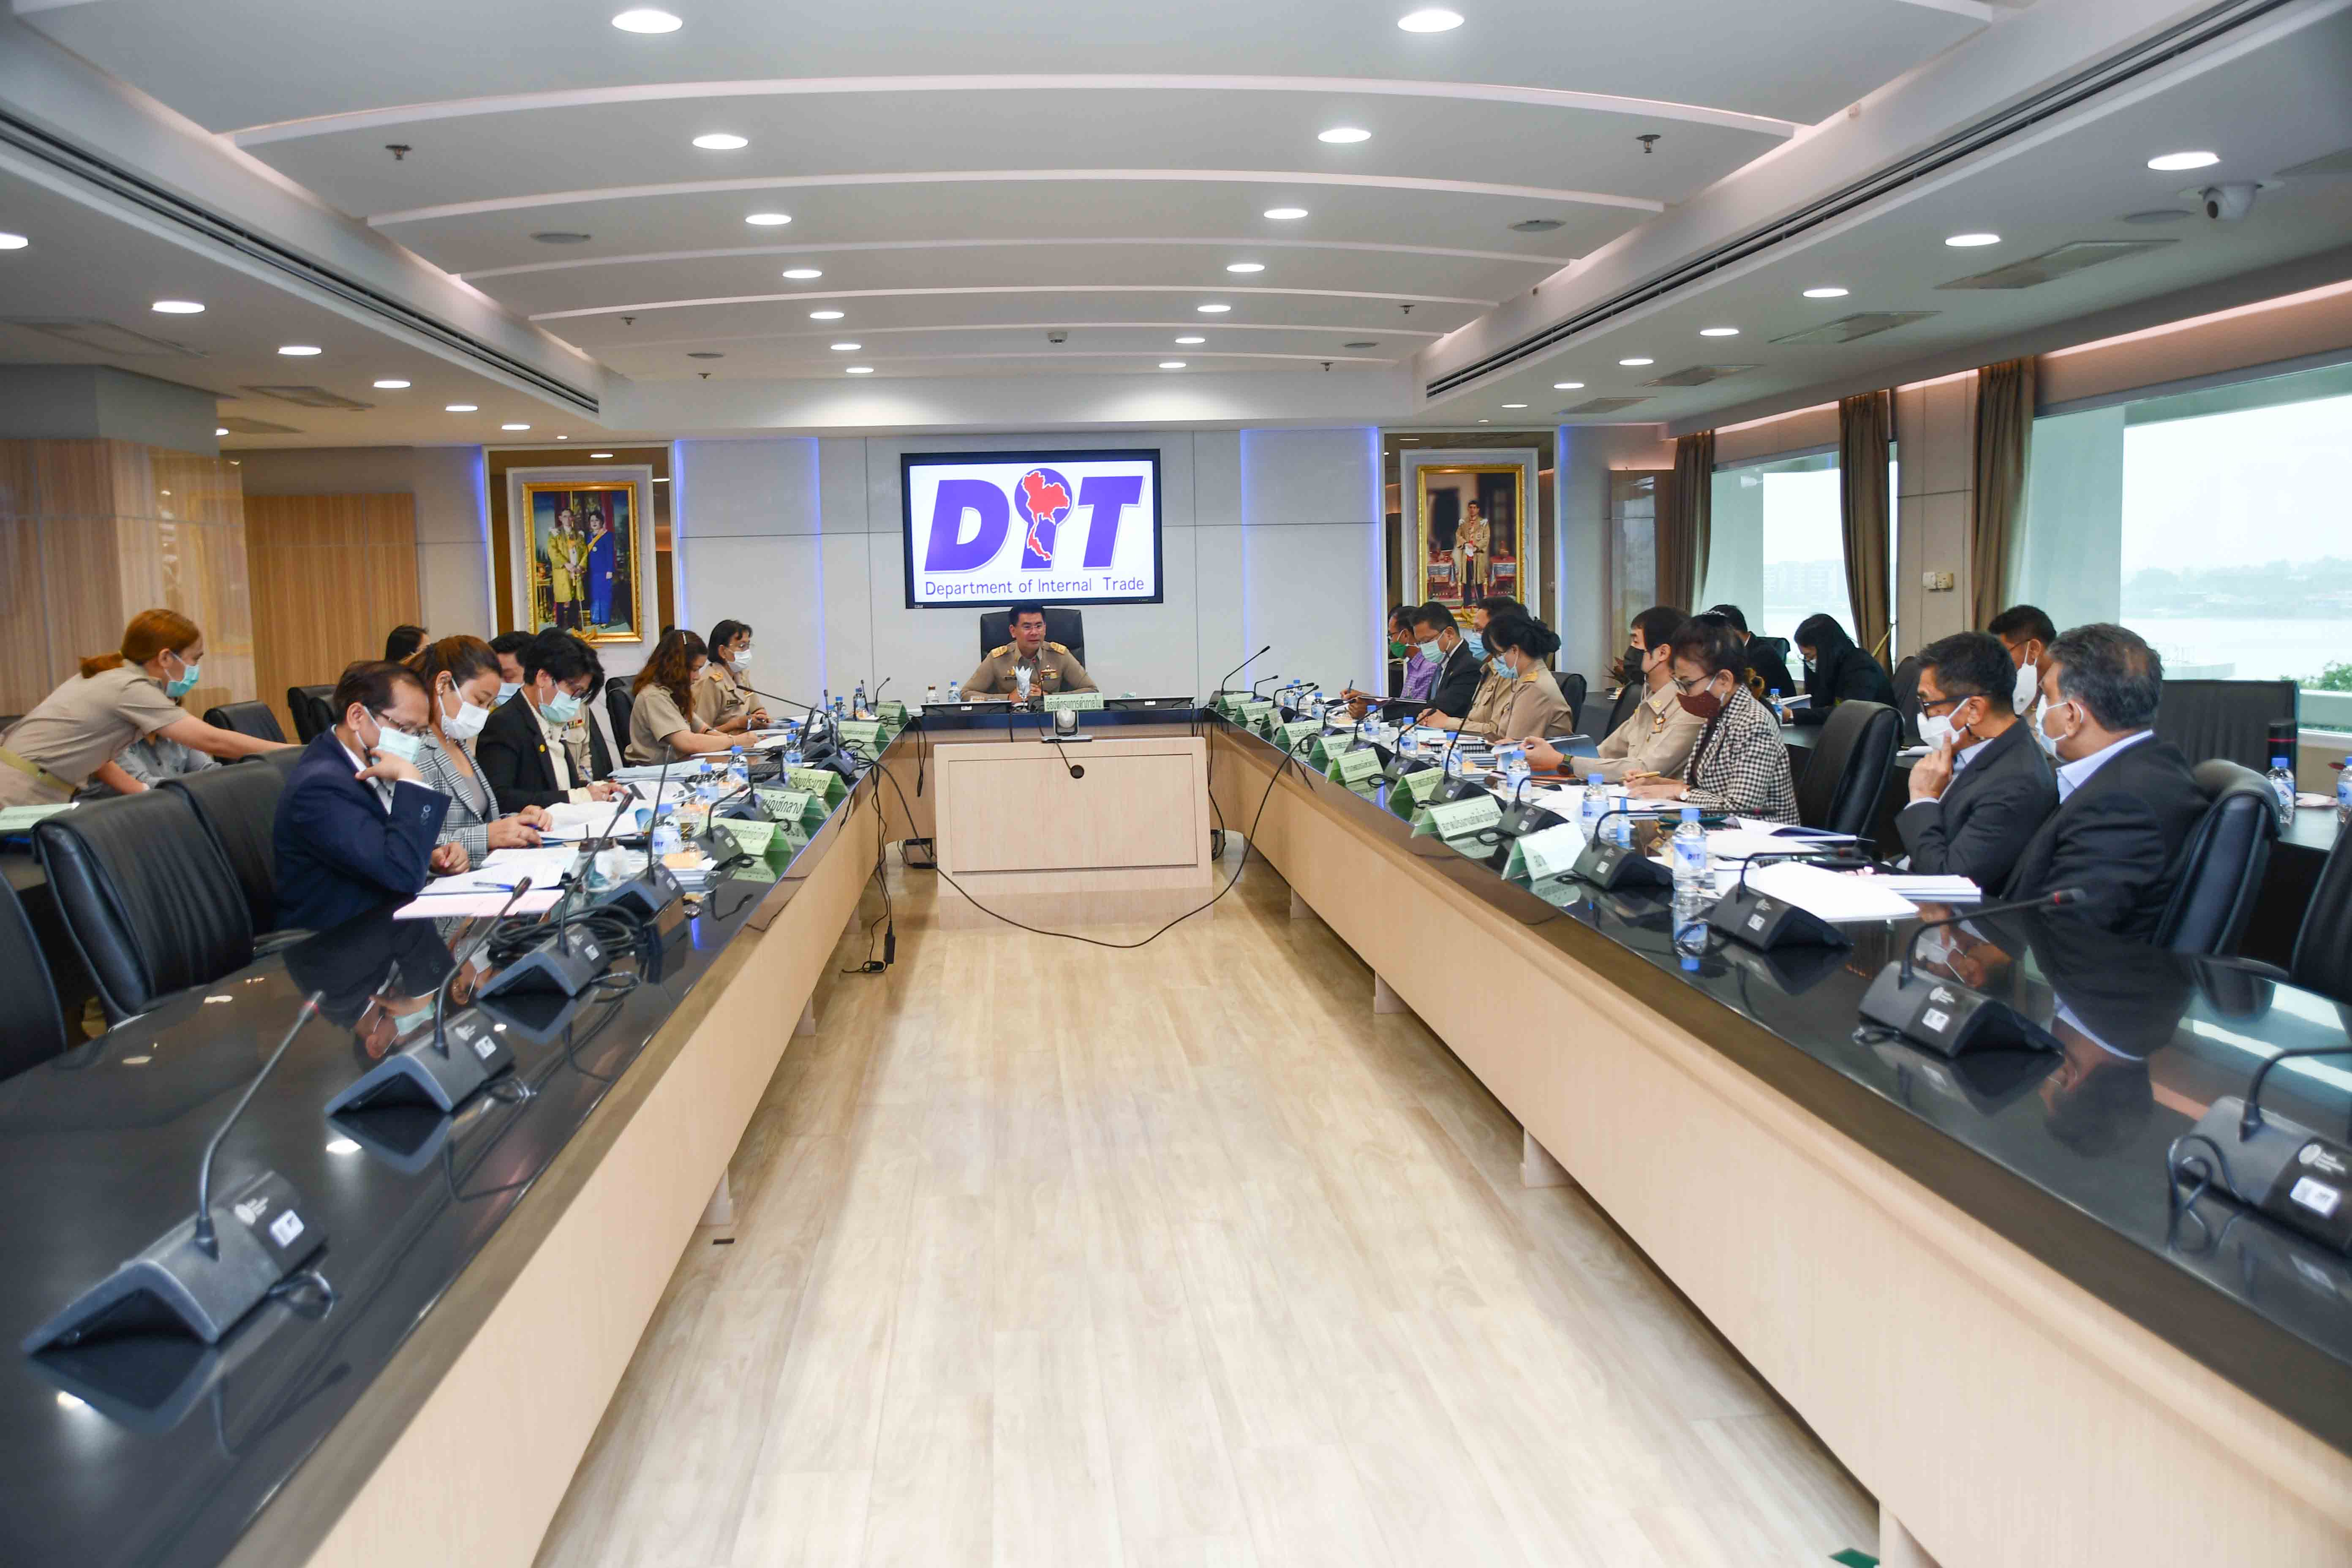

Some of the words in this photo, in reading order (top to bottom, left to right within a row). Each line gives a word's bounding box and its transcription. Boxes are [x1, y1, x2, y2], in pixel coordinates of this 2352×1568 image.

[924, 467, 1145, 574] DIT
[926, 580, 1013, 599] Department
[1018, 579, 1033, 593] of
[1038, 578, 1092, 592] Internal
[1102, 577, 1144, 591] Trade
